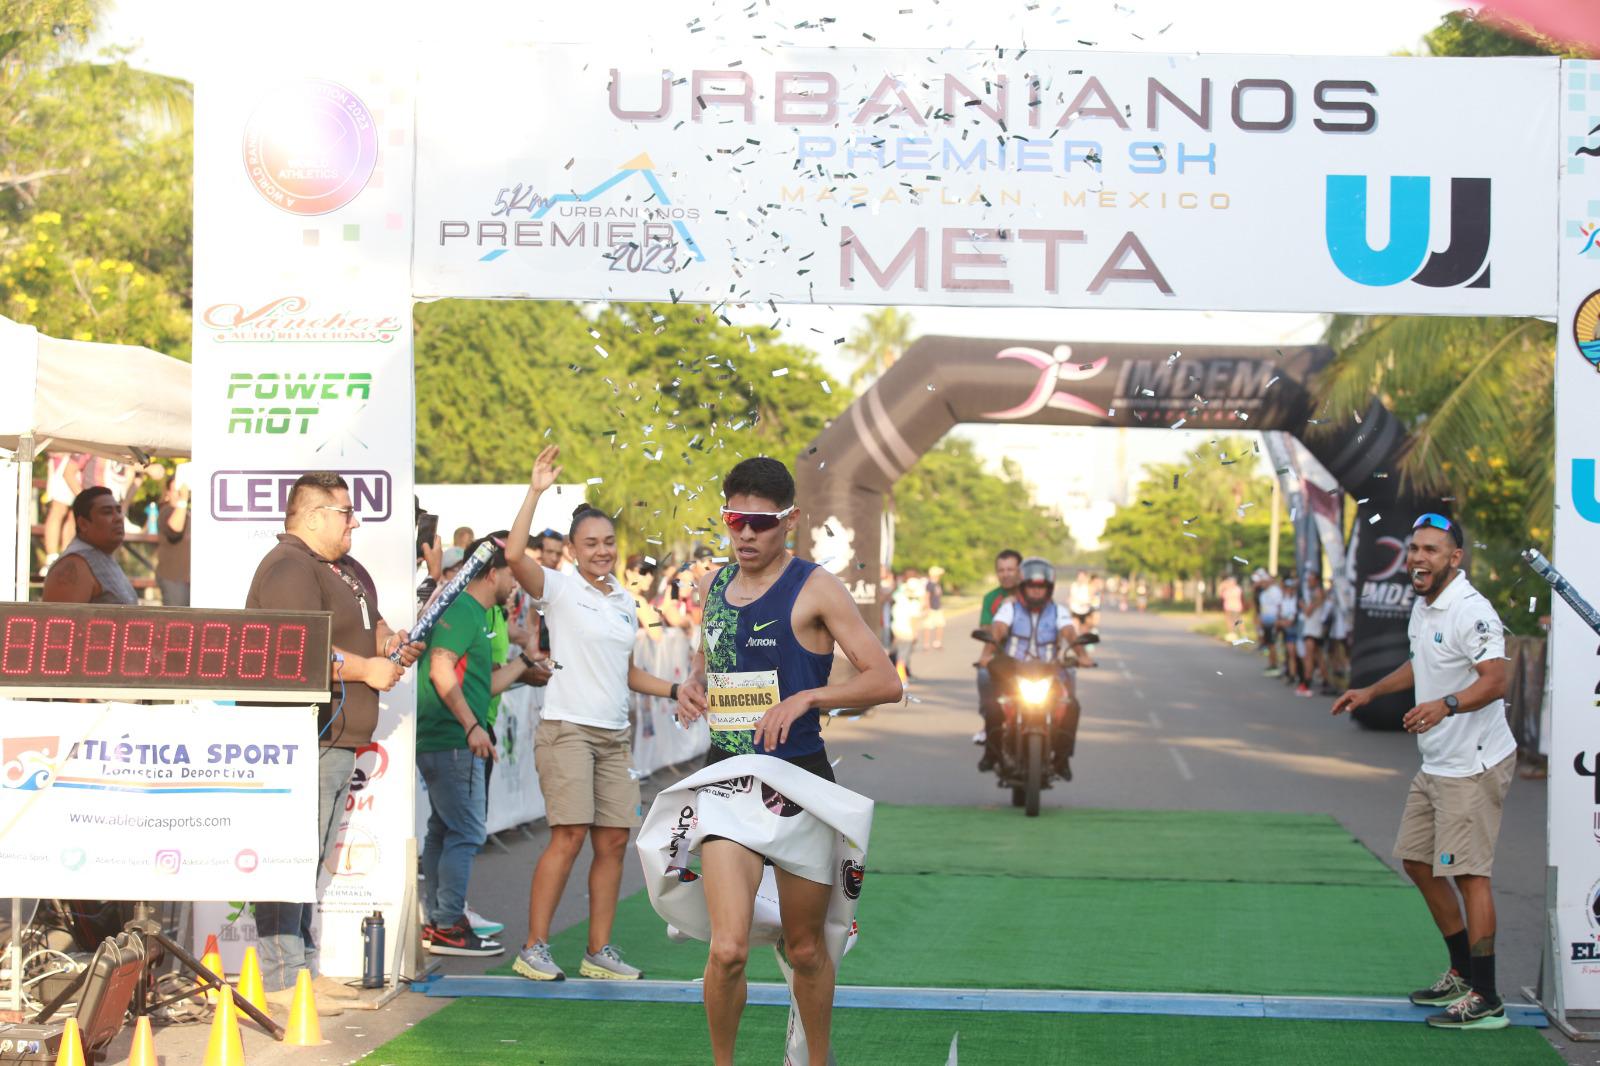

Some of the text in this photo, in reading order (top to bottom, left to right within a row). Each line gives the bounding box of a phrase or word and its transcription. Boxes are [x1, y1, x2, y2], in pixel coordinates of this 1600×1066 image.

[608, 68, 1379, 134] URBANIANOS
[797, 136, 1103, 174] PREMIER
[560, 206, 701, 220] URBANIANOS
[1063, 190, 1231, 211] MEXICO
[439, 220, 675, 247] PREMIER
[840, 226, 1177, 296] META
[226, 372, 373, 399] POWER
[218, 477, 384, 512] LEN
[1360, 581, 1417, 607] IMDE
[746, 636, 777, 648] AKRON
[719, 692, 773, 707] BARCENAS
[207, 744, 299, 765] SPORT
